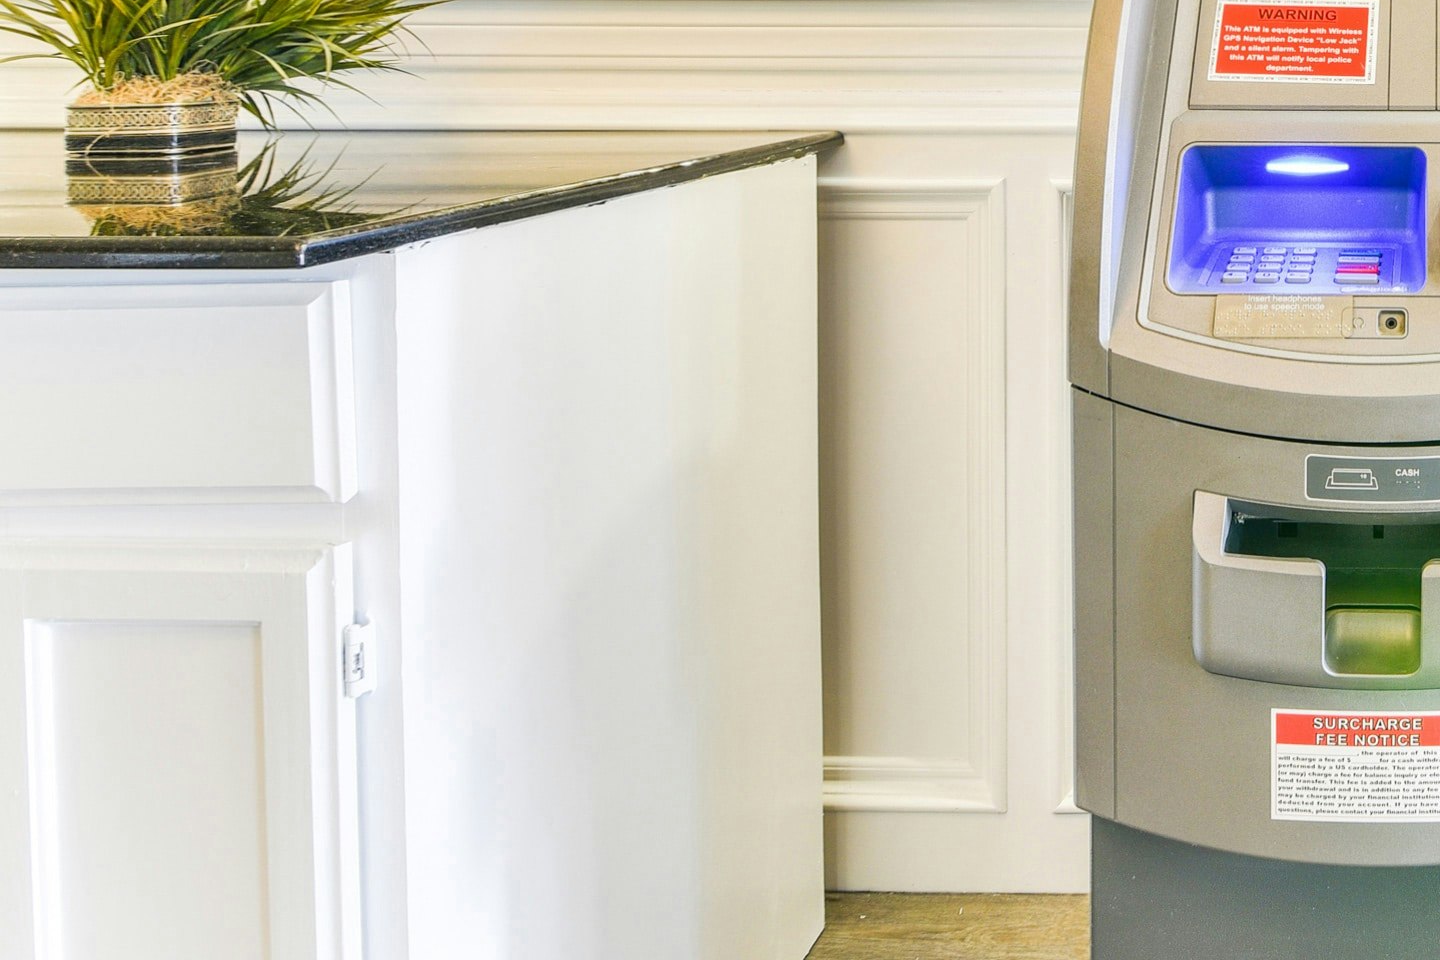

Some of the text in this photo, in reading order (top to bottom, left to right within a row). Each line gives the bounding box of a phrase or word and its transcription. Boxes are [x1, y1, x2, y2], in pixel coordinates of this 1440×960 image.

[1259, 8, 1337, 21] WARNING
[1271, 27, 1308, 35] equipped
[1243, 35, 1286, 44] Navigation
[1298, 46, 1341, 55] Tampering
[1282, 55, 1304, 63] notify
[1327, 56, 1352, 64] police
[1266, 64, 1314, 72] department.
[1272, 295, 1322, 304] headphones
[1271, 303, 1301, 311] speech
[1395, 469, 1420, 477] CASH
[1313, 717, 1423, 731] SURCHARGE
[1316, 733, 1420, 747] FEE NOTICE
